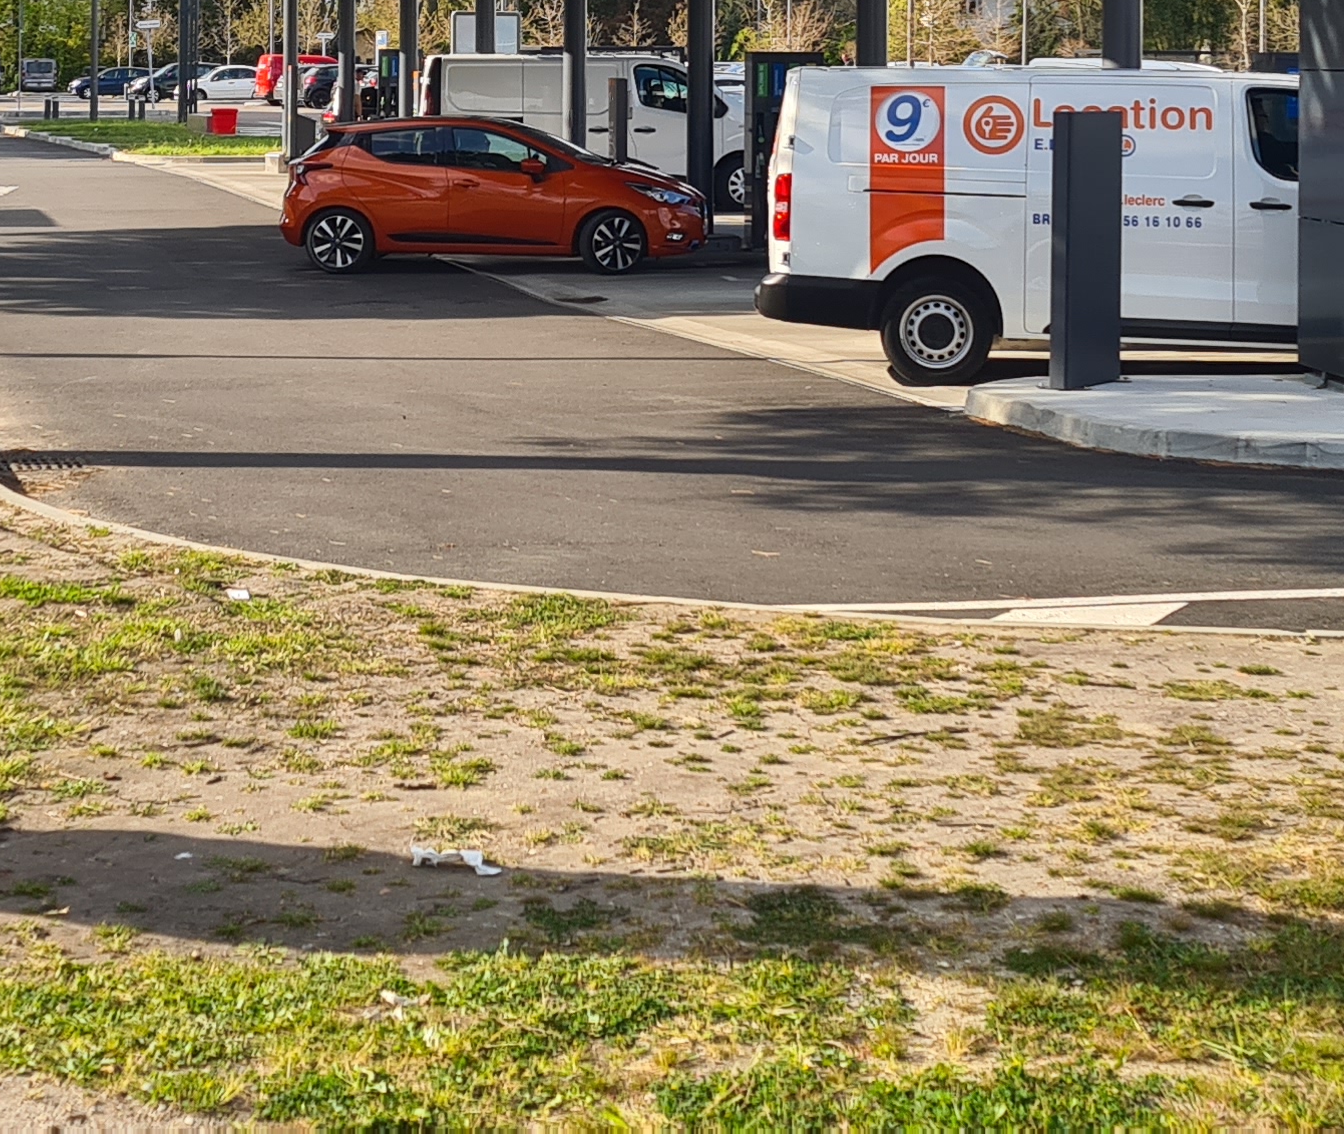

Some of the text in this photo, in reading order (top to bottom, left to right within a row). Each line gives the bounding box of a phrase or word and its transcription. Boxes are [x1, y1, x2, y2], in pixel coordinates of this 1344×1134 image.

[874, 152, 939, 164] PAR JOUR
[1165, 216, 1181, 228] 10
